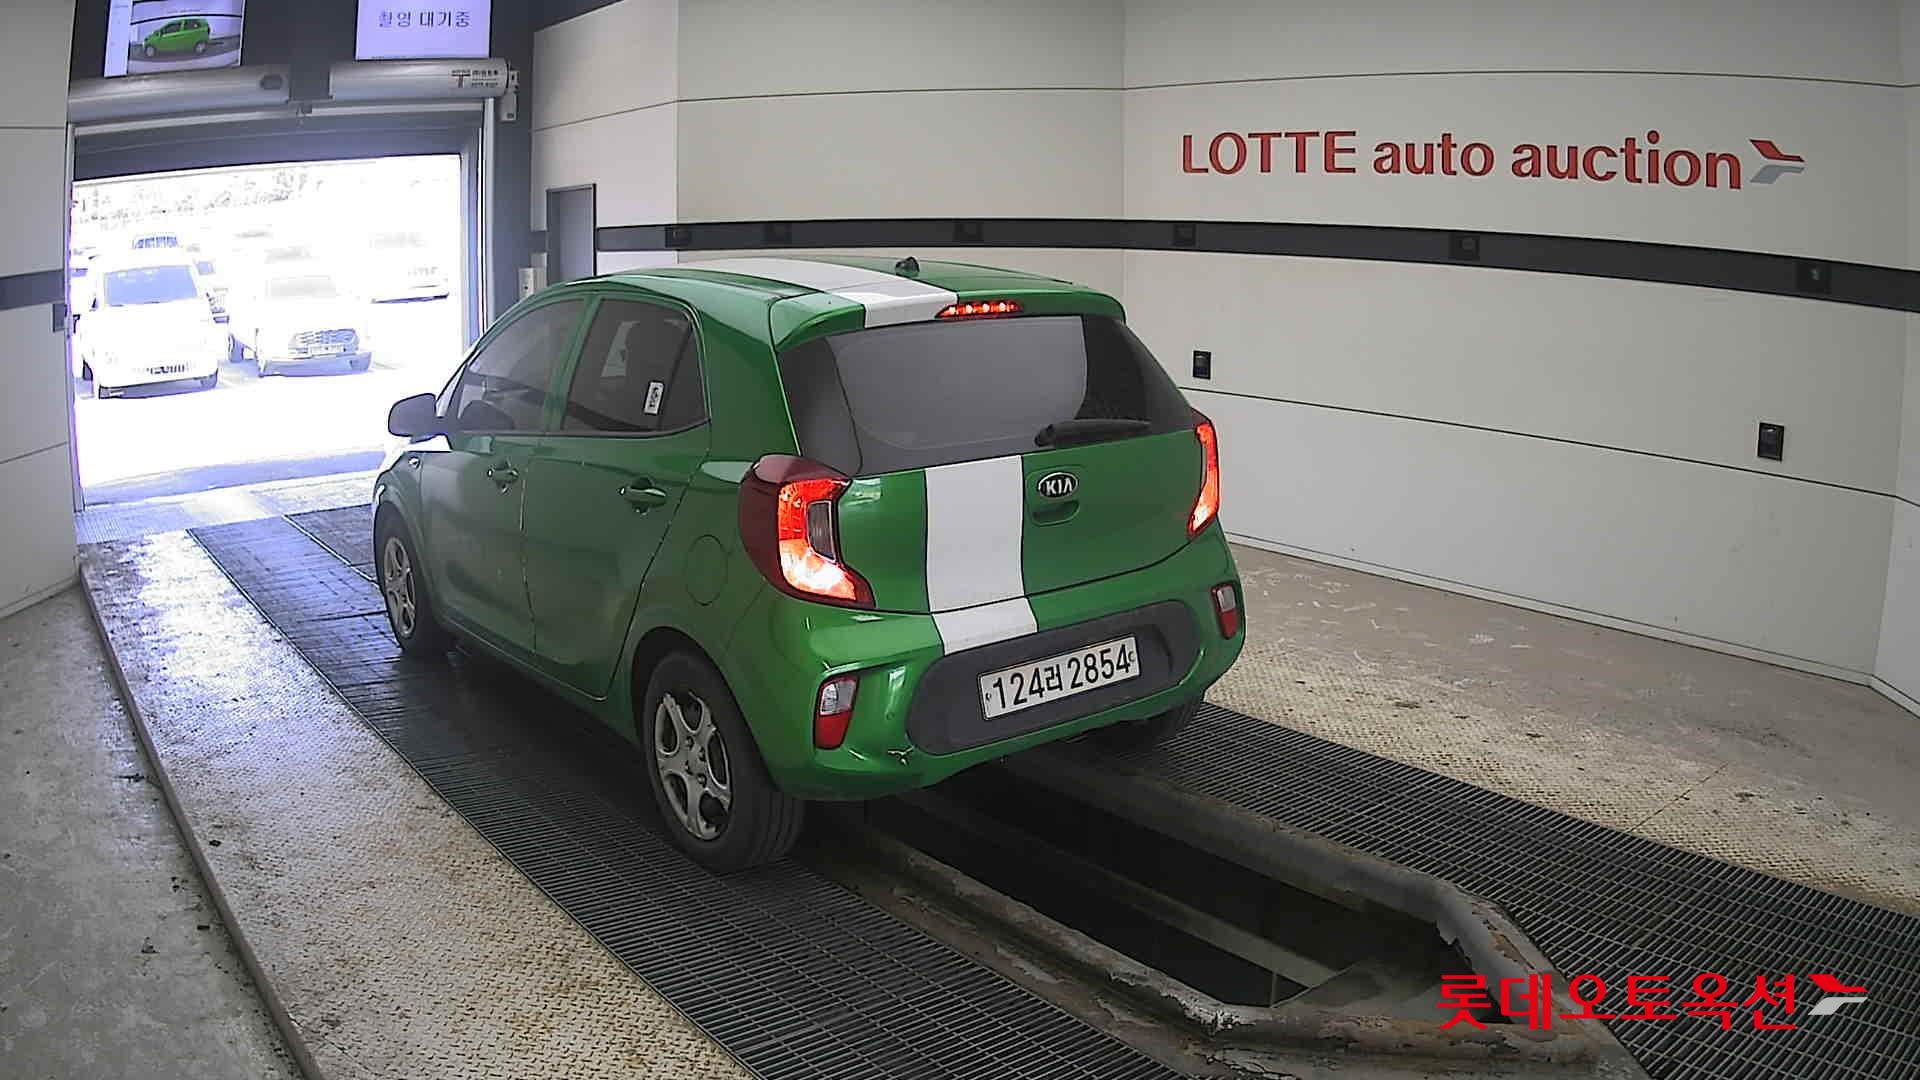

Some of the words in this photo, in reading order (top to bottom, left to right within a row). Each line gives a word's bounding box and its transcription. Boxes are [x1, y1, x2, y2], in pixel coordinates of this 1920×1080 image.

[420, 11, 470, 28] 대기중
[1182, 130, 1357, 174] LOTTE
[1373, 132, 1495, 177] auto
[1510, 129, 1742, 190] auction
[1046, 477, 1073, 495] KIA
[993, 663, 1064, 709] 124러
[1066, 643, 1131, 690] 2854
